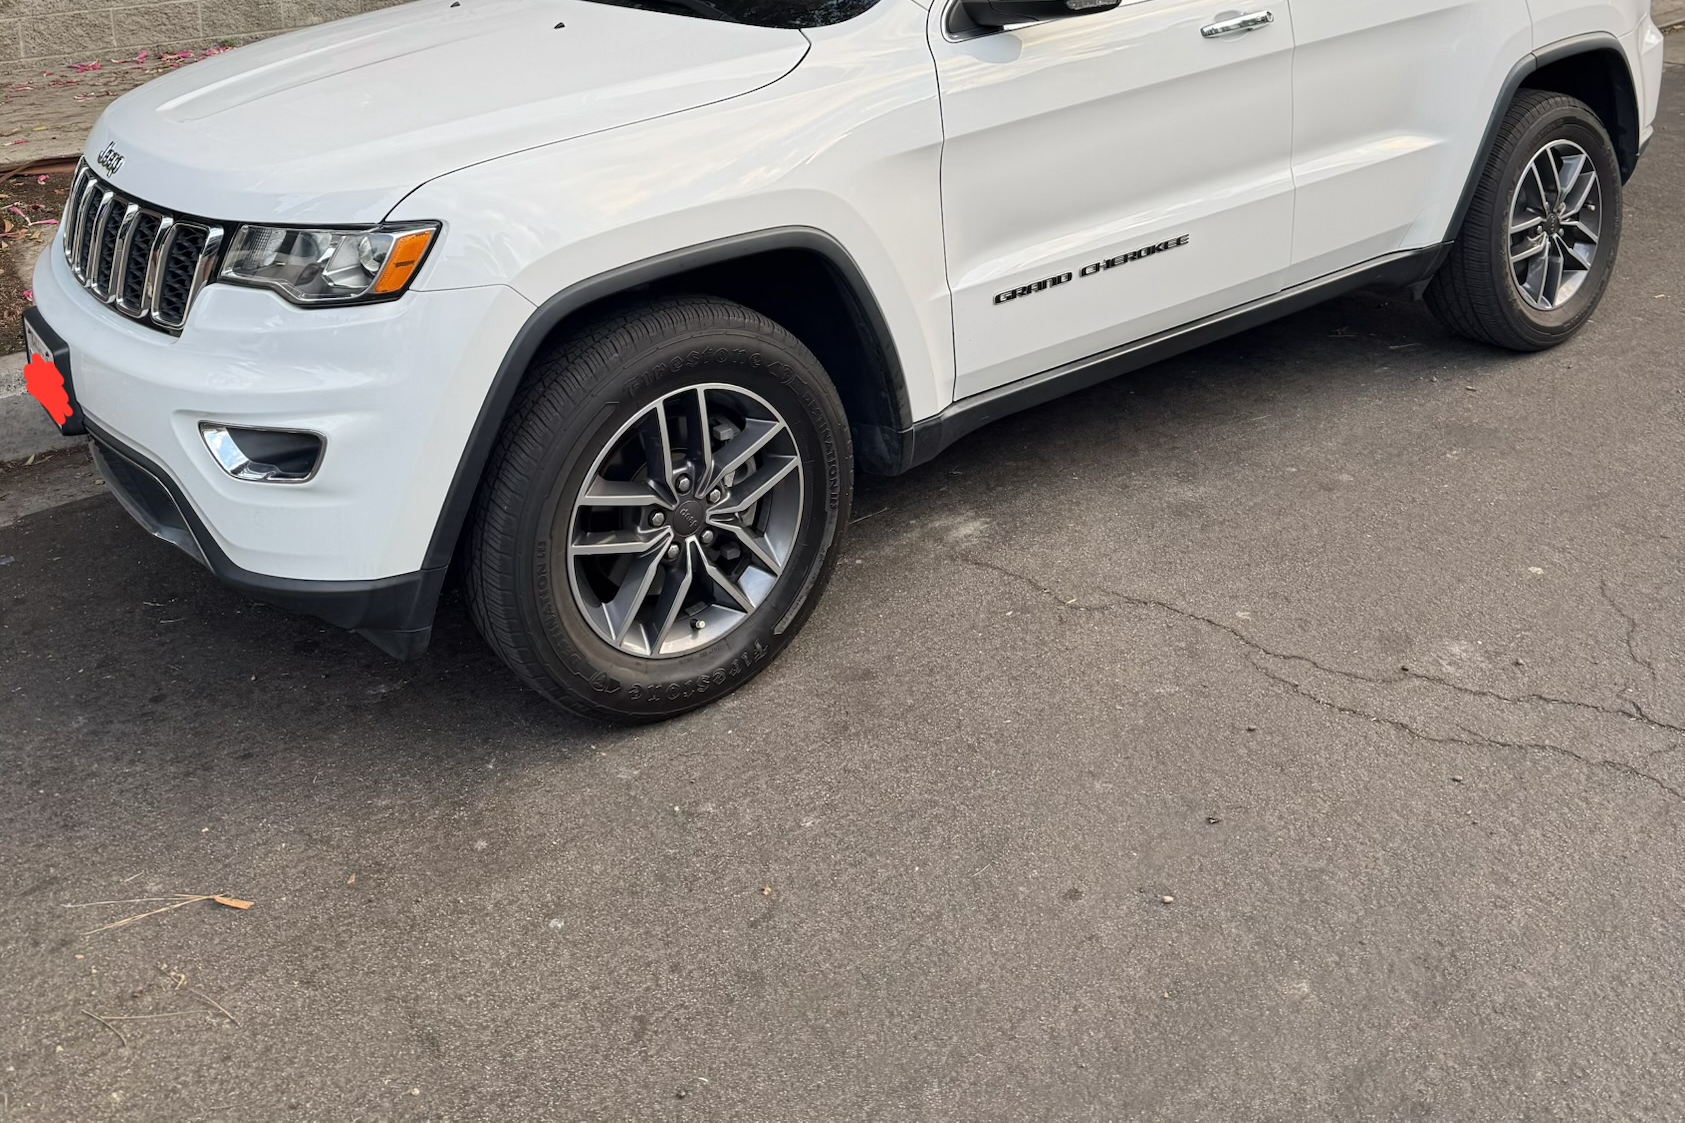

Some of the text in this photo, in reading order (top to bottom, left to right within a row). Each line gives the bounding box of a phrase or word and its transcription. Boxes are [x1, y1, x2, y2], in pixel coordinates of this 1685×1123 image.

[98, 141, 124, 178] Jeep
[993, 234, 1190, 305] GRAND CHEROKEE
[623, 346, 762, 398] Firestone
[628, 639, 769, 701] Firestone
